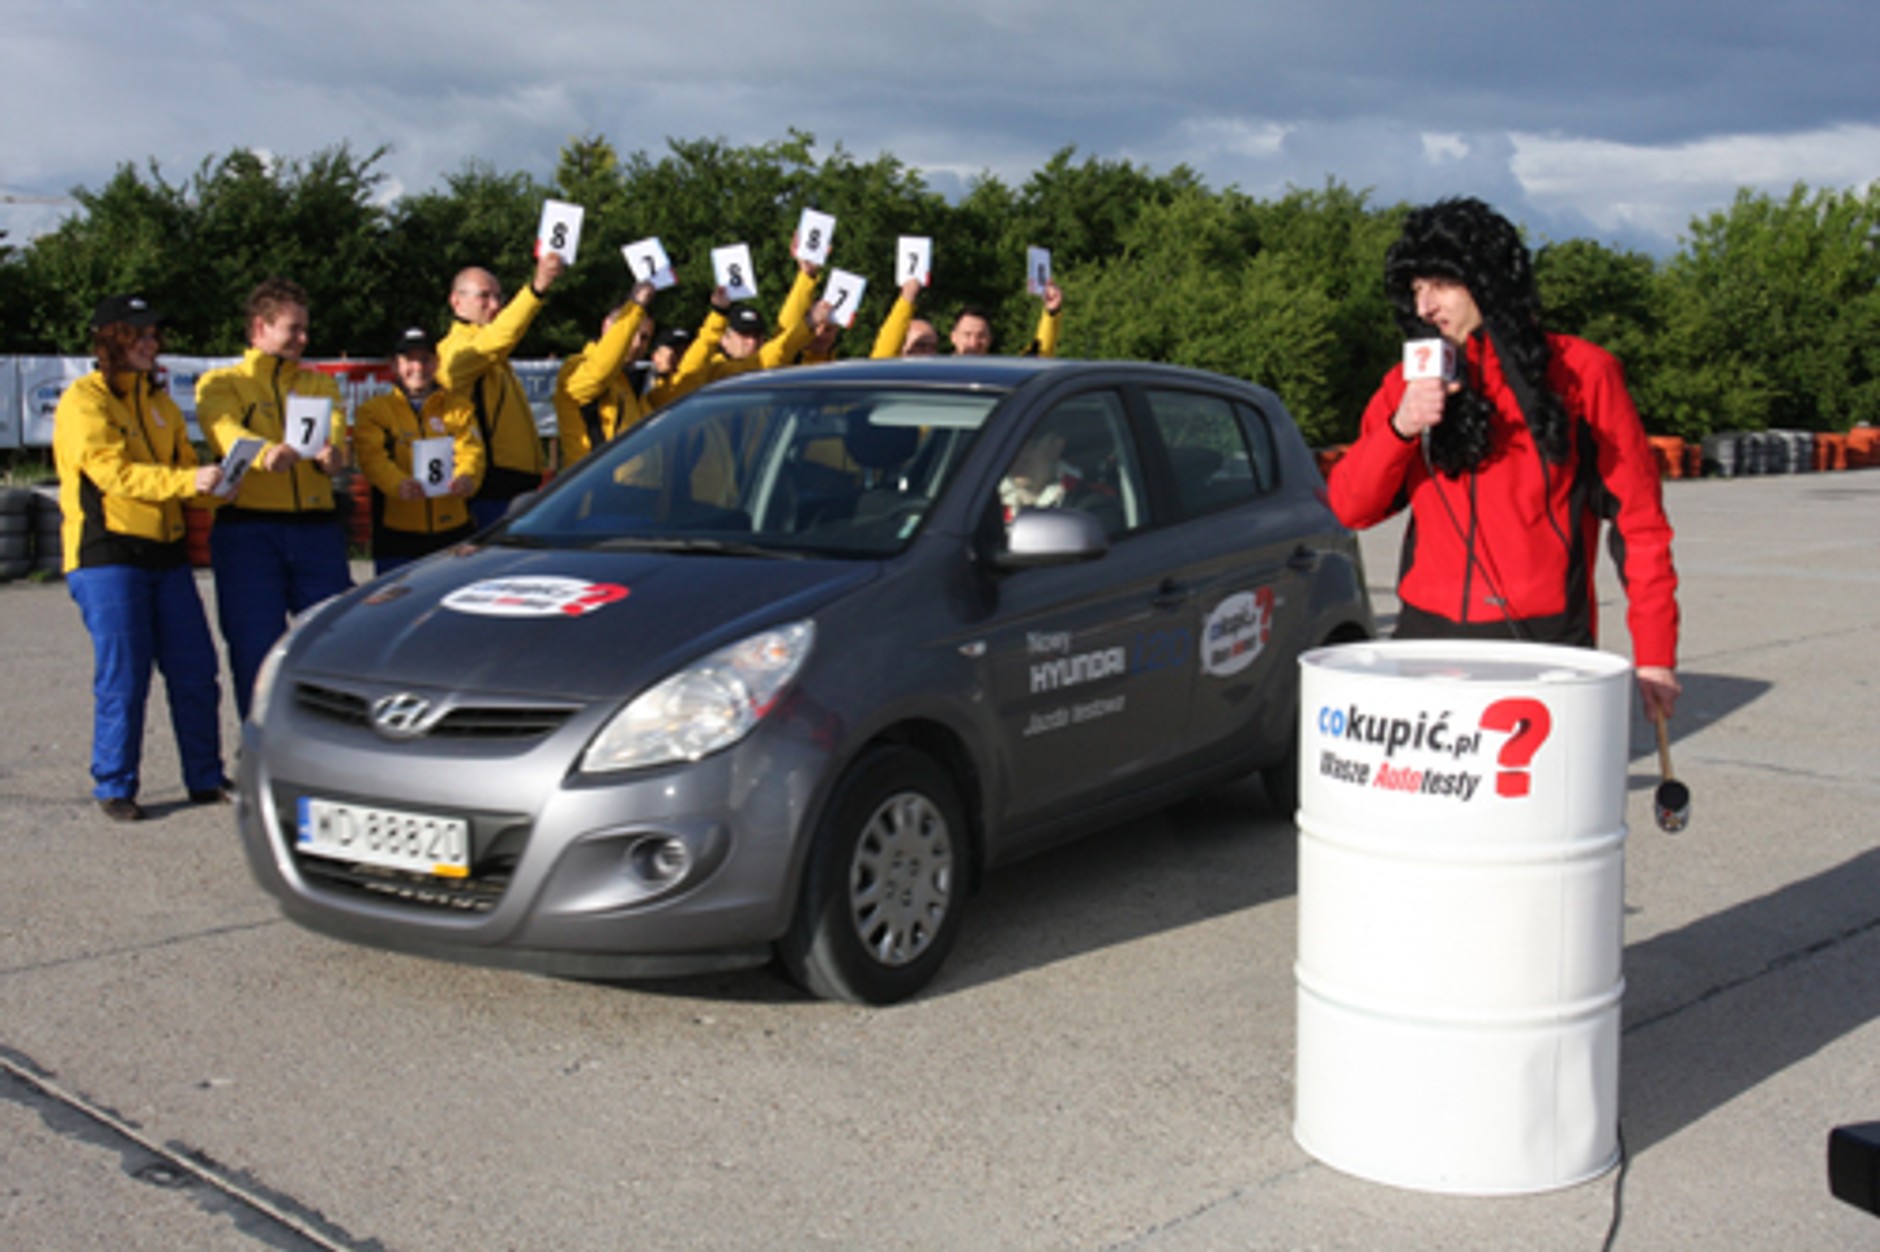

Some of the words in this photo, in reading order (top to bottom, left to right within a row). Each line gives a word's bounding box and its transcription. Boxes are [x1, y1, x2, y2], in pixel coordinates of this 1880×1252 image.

[549, 222, 568, 249] 8
[805, 228, 822, 251] 8
[642, 255, 657, 277] 7
[726, 263, 743, 288] 8
[301, 417, 316, 444] 7
[428, 458, 443, 485] 8
[1030, 646, 1126, 693] HYUNDAI
[1318, 704, 1482, 758] cokupić.pl
[1320, 750, 1370, 786] Wasze
[1373, 762, 1482, 801] Autotesty
[366, 812, 463, 862] 88820
